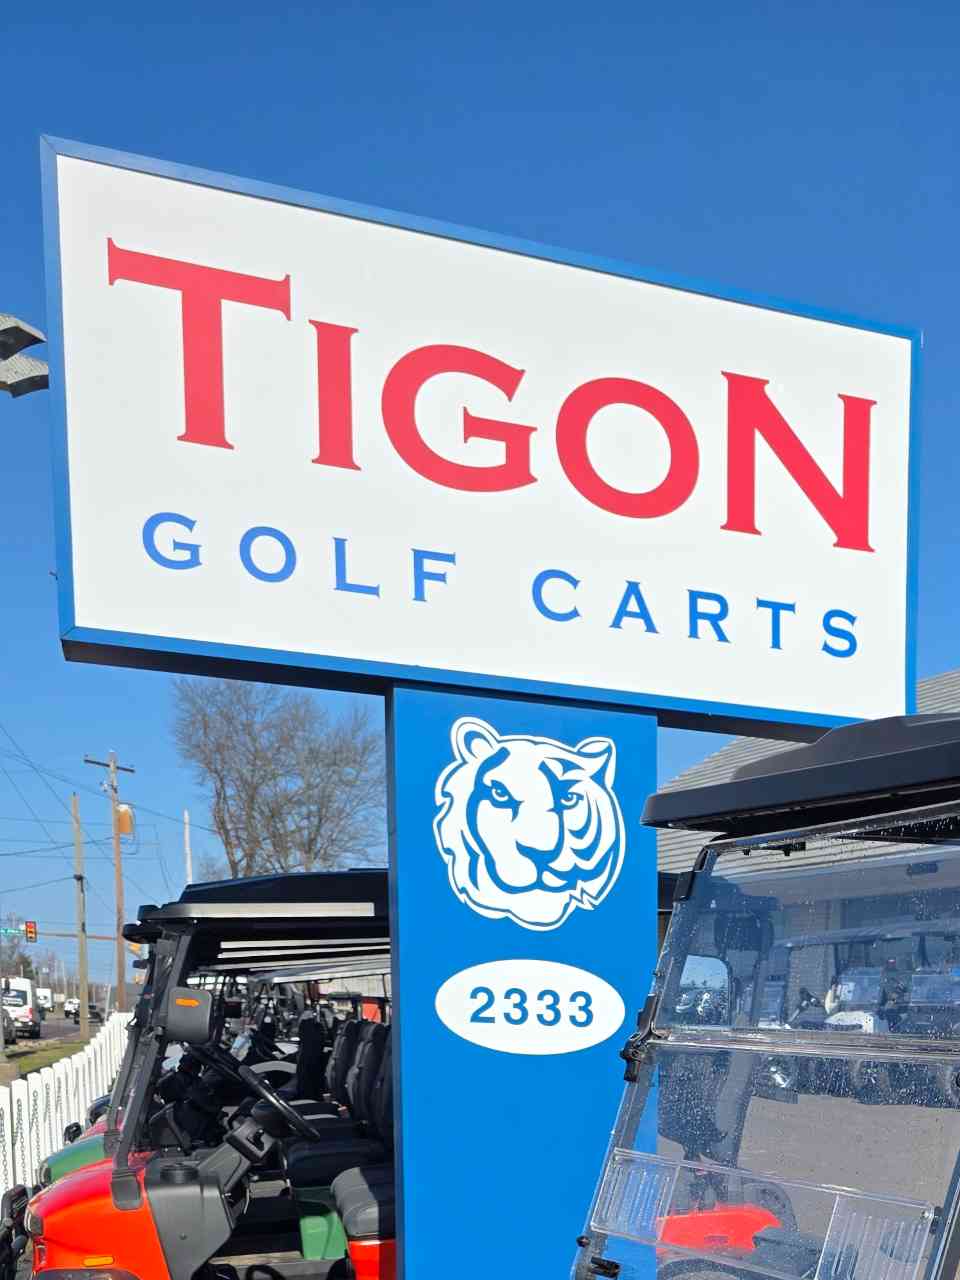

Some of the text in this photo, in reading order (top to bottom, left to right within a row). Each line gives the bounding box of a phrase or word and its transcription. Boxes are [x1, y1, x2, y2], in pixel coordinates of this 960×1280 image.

[107, 237, 878, 553] TIGON
[142, 511, 858, 658] GOLF CARTS
[469, 985, 594, 1028] 2333
